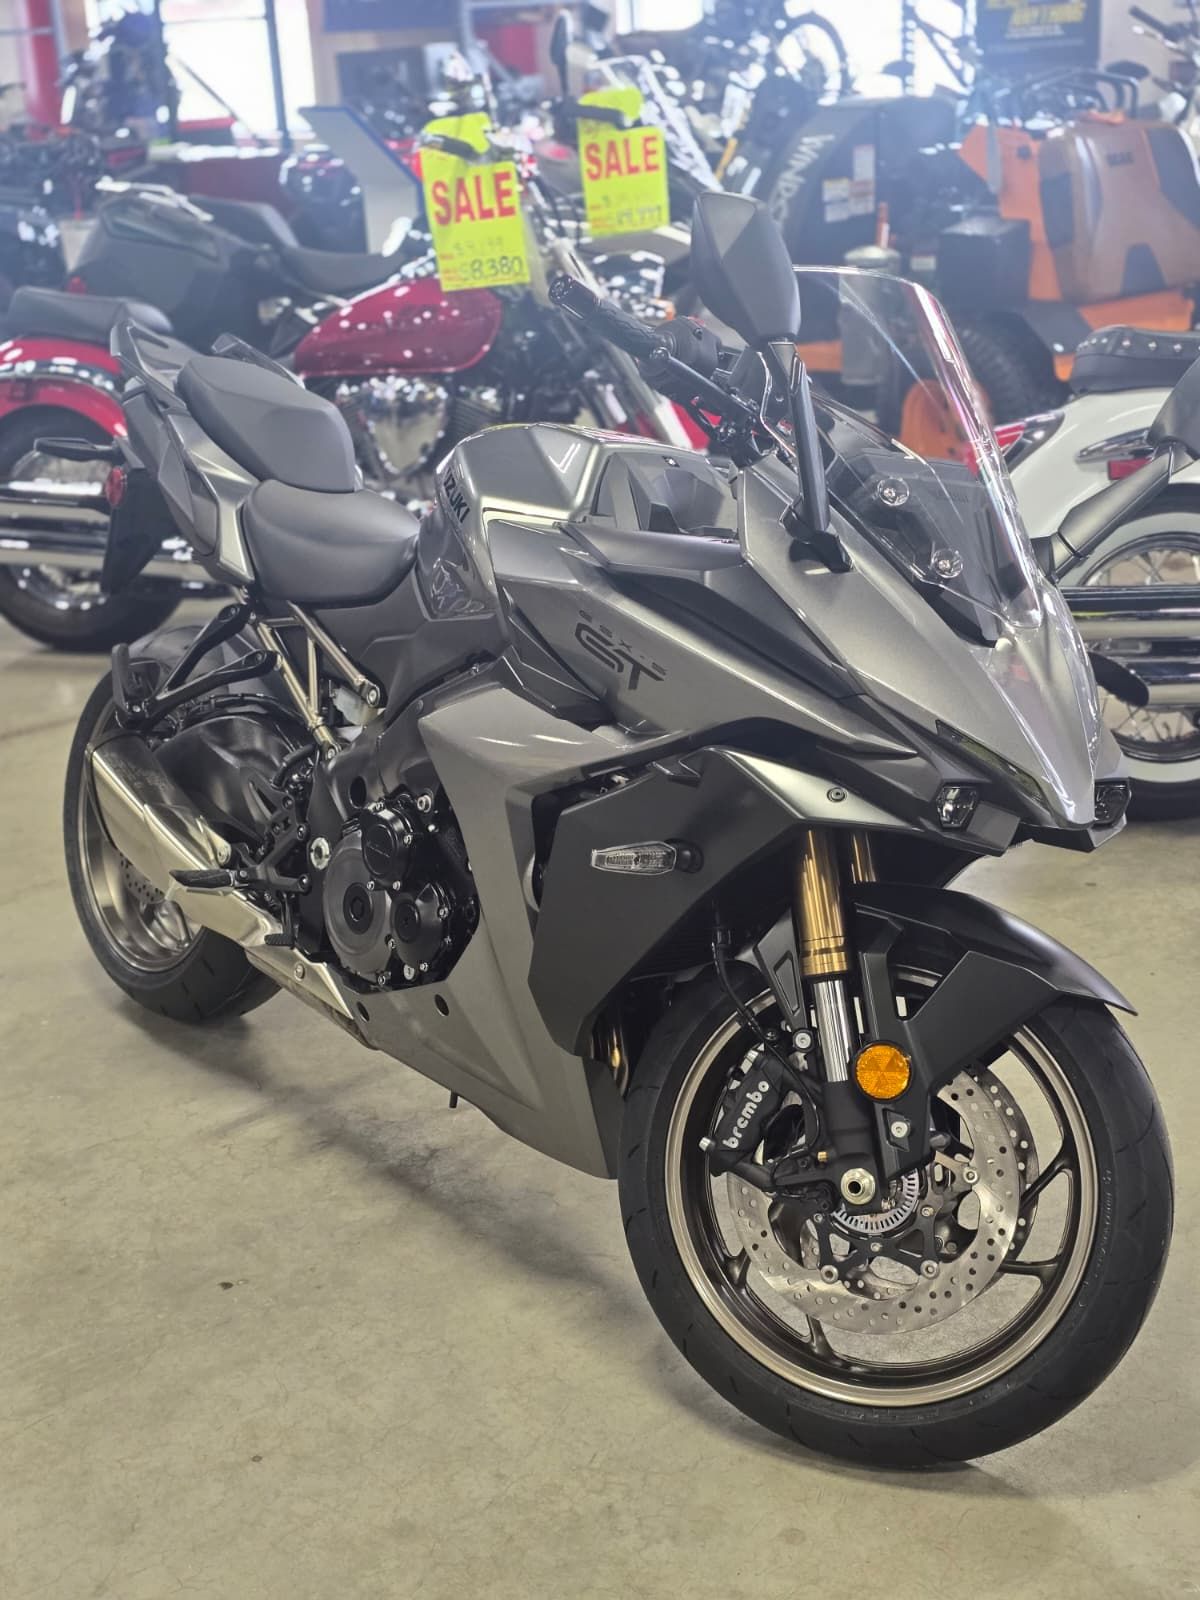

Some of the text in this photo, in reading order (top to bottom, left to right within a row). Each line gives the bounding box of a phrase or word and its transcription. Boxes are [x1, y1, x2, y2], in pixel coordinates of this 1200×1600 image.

[585, 136, 660, 181] SALE
[432, 171, 516, 226] SALE
[575, 622, 665, 690] GT
[722, 1080, 770, 1149] brembo
